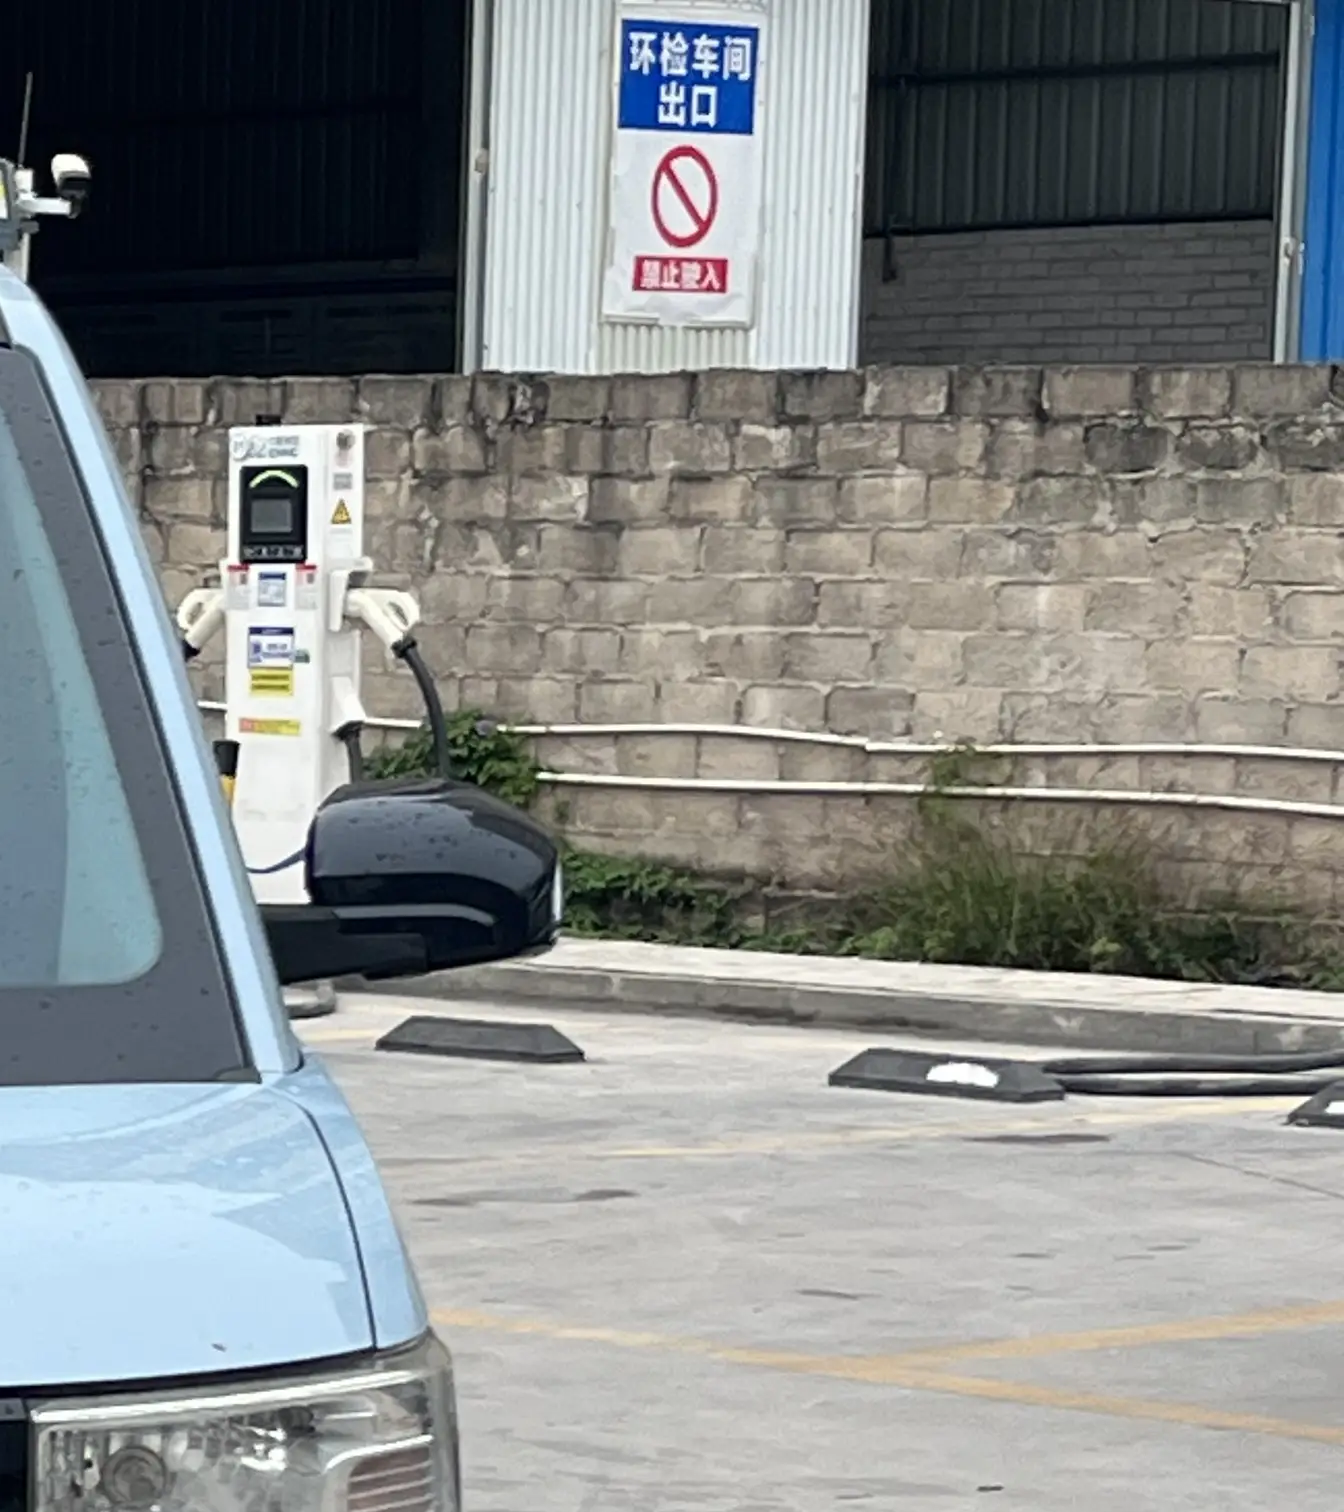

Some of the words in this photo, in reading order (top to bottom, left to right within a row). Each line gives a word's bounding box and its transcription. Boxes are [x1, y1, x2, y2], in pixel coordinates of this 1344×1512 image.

[628, 31, 752, 81] 环检车间
[658, 80, 718, 128] 出口
